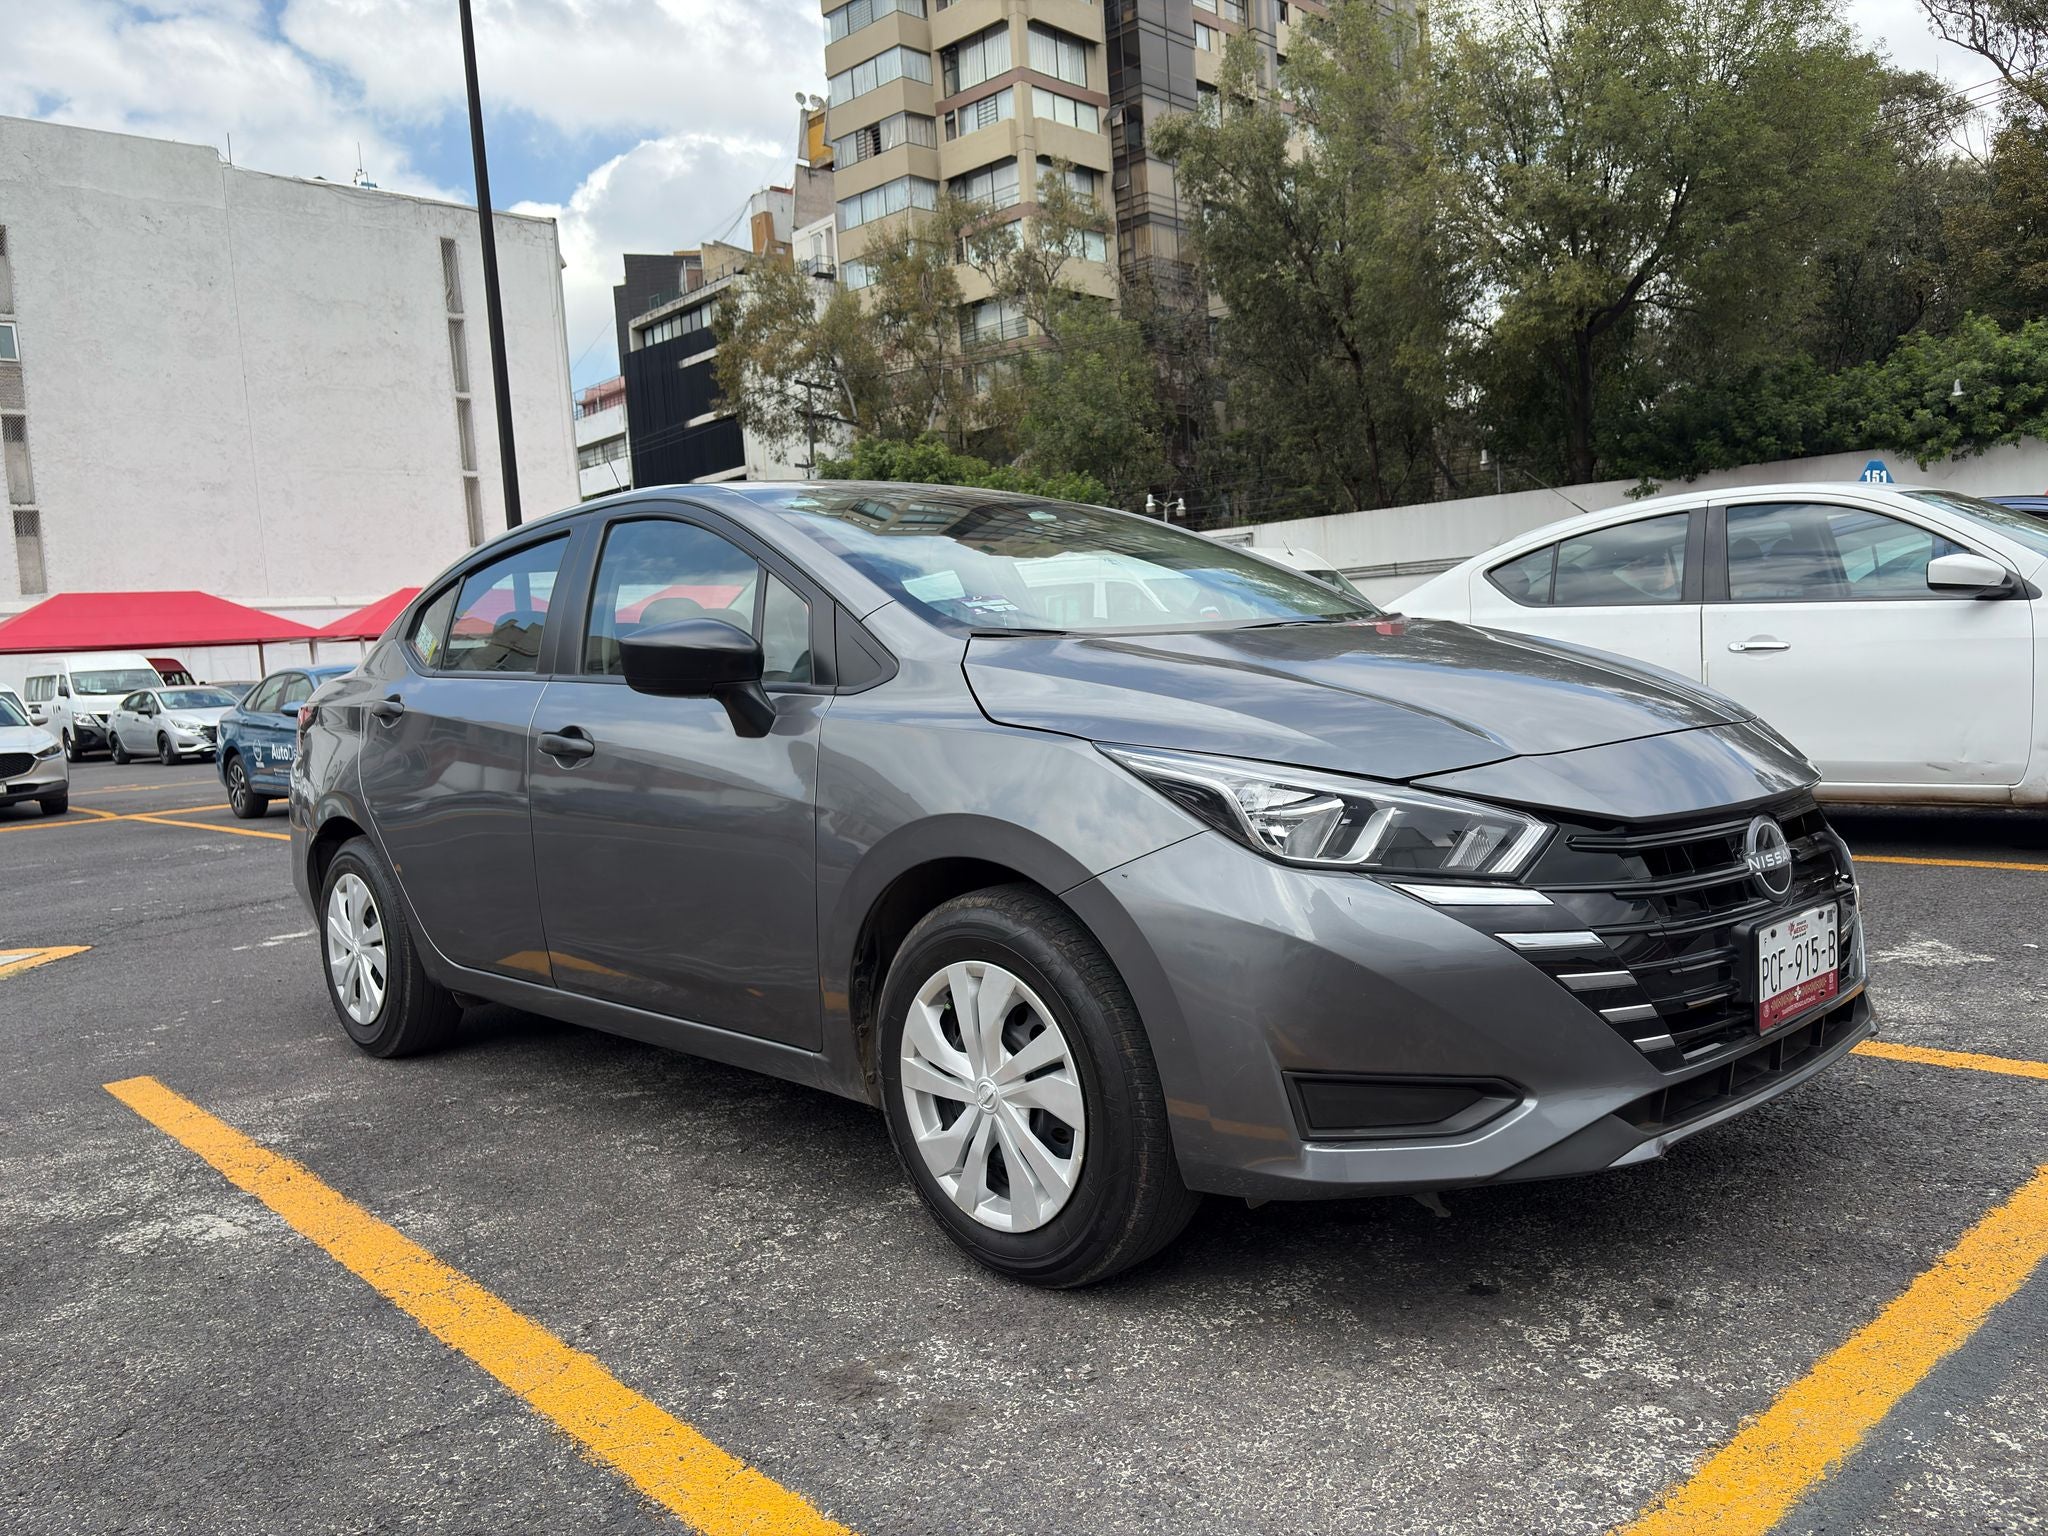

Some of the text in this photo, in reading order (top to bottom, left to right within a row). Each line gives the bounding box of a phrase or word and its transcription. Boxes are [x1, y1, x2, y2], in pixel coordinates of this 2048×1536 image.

[1865, 470, 1887, 483] 151
[1748, 849, 1791, 870] NISSA
[1762, 930, 1836, 998] PCF-915-B
